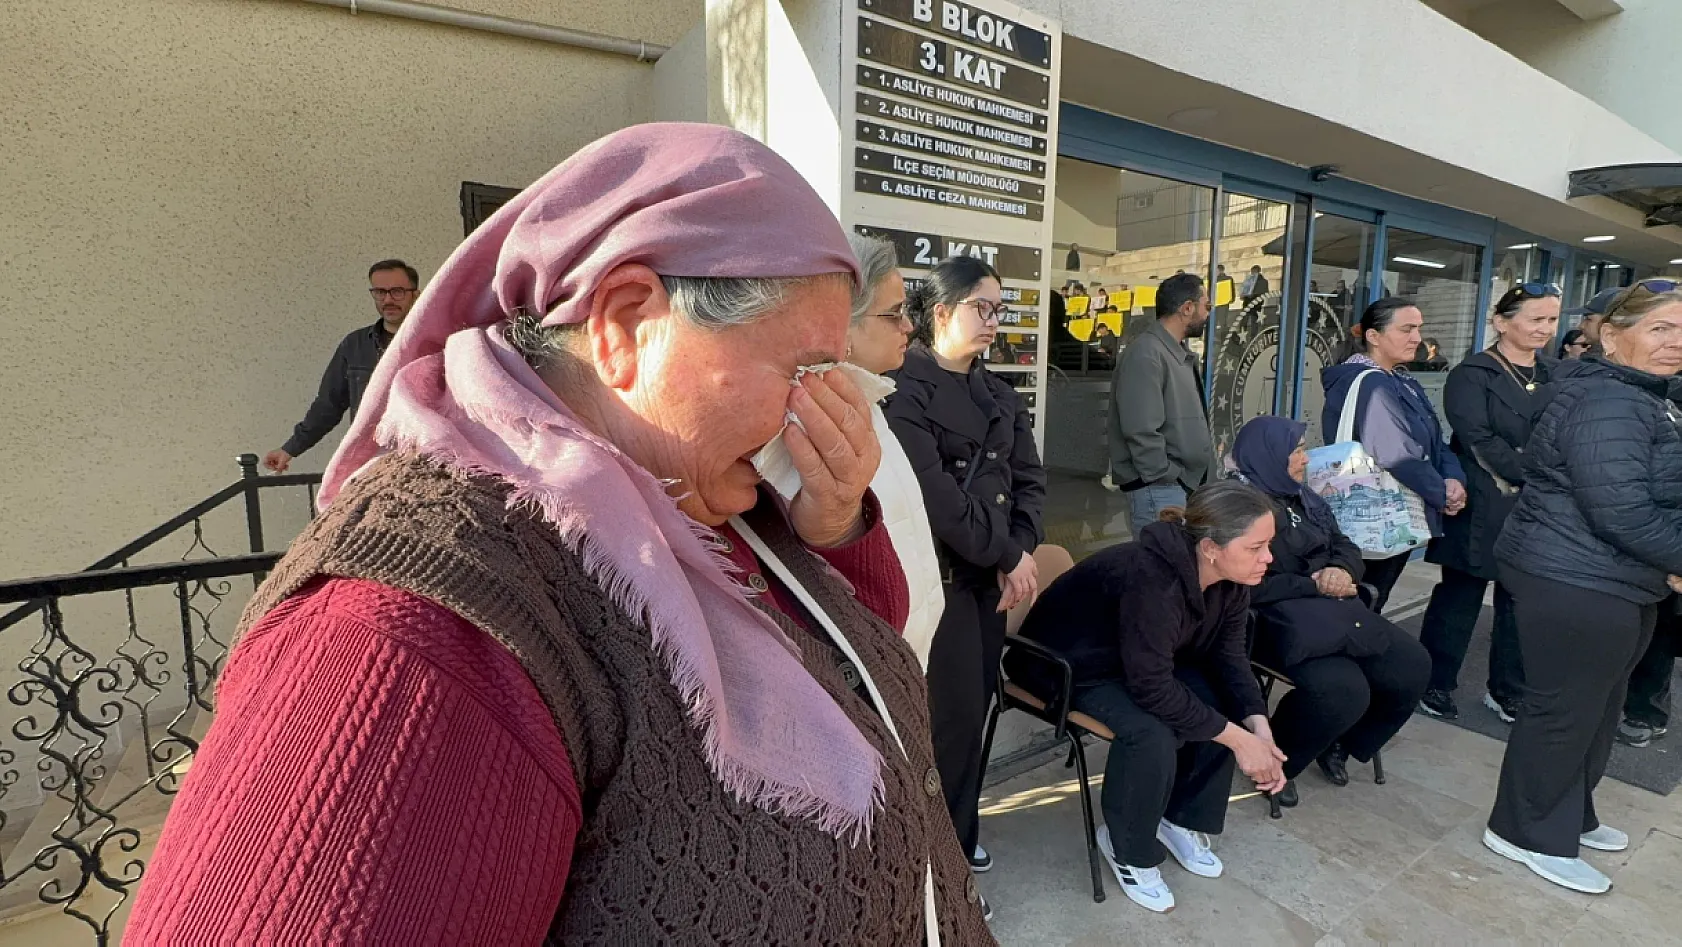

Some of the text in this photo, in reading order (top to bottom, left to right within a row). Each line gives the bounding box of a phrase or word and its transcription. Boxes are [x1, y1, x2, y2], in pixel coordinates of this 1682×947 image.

[913, 0, 1015, 51] B BLOK
[920, 42, 1007, 90] 3. KAT
[879, 75, 1034, 125] 1. ASLİYE HUKUK MAHKEMESİ
[879, 102, 1033, 149] 2. ASLİYE HUKUK MAHKEMESİ
[878, 129, 1032, 172] 3. ASLİYE HUKUK MAHKEMESİ
[893, 156, 1020, 193] İLÇE SEÇİM MÜDÜRLÜĞÜ
[881, 181, 1027, 216] 6. ASLİYE CEZA MAHKEMESİ
[914, 237, 939, 265] 2.
